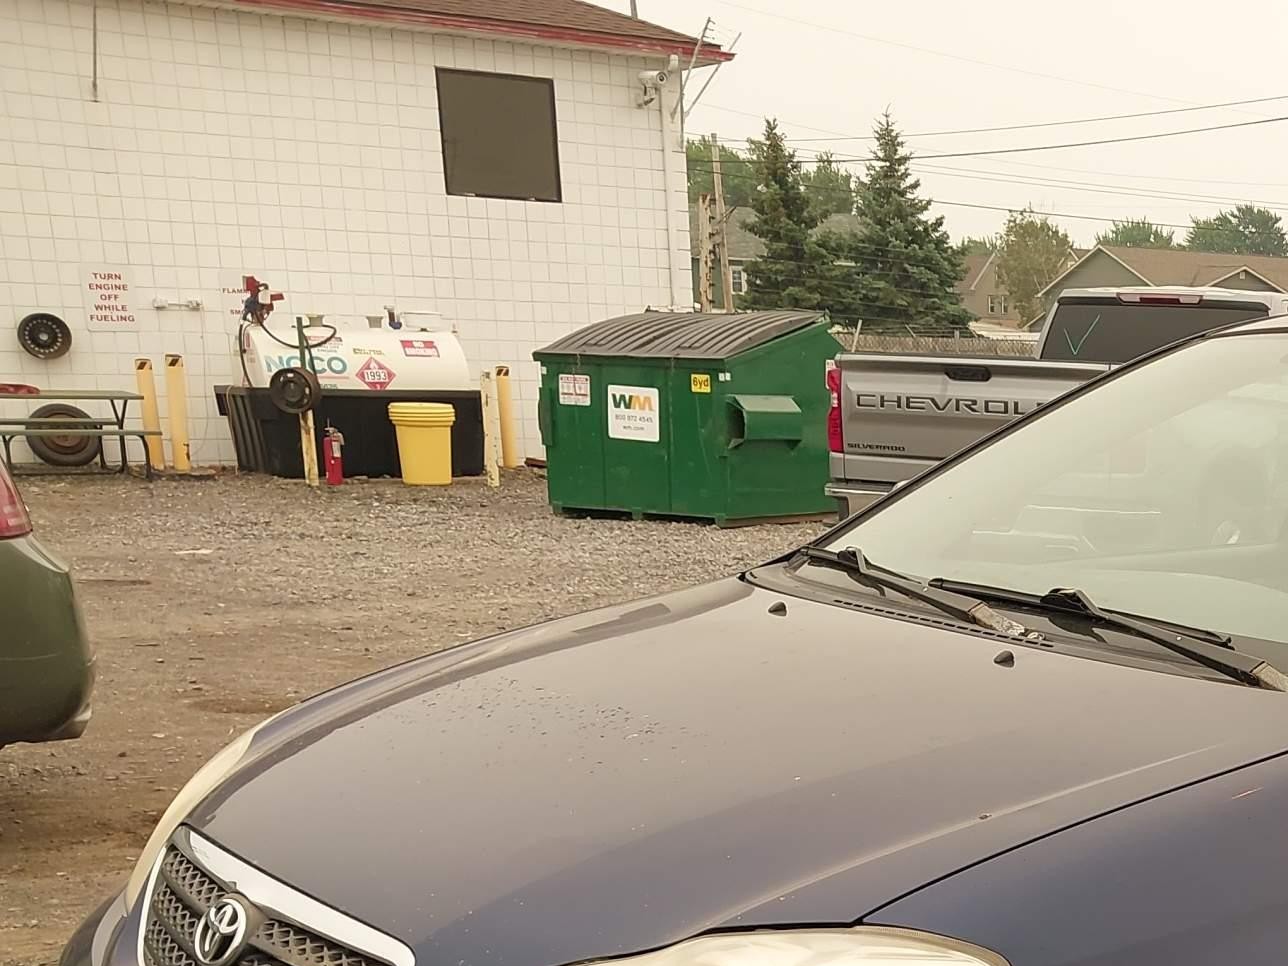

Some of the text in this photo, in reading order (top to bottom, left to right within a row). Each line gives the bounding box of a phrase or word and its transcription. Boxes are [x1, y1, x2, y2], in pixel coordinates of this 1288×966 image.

[92, 272, 121, 280] TURN
[89, 283, 128, 291] ENGINE
[90, 314, 135, 322] FUELING
[366, 371, 387, 381] 1993
[611, 393, 654, 411] WM
[856, 393, 1046, 416] CHEVROL
[847, 442, 906, 452] SILVERADO
